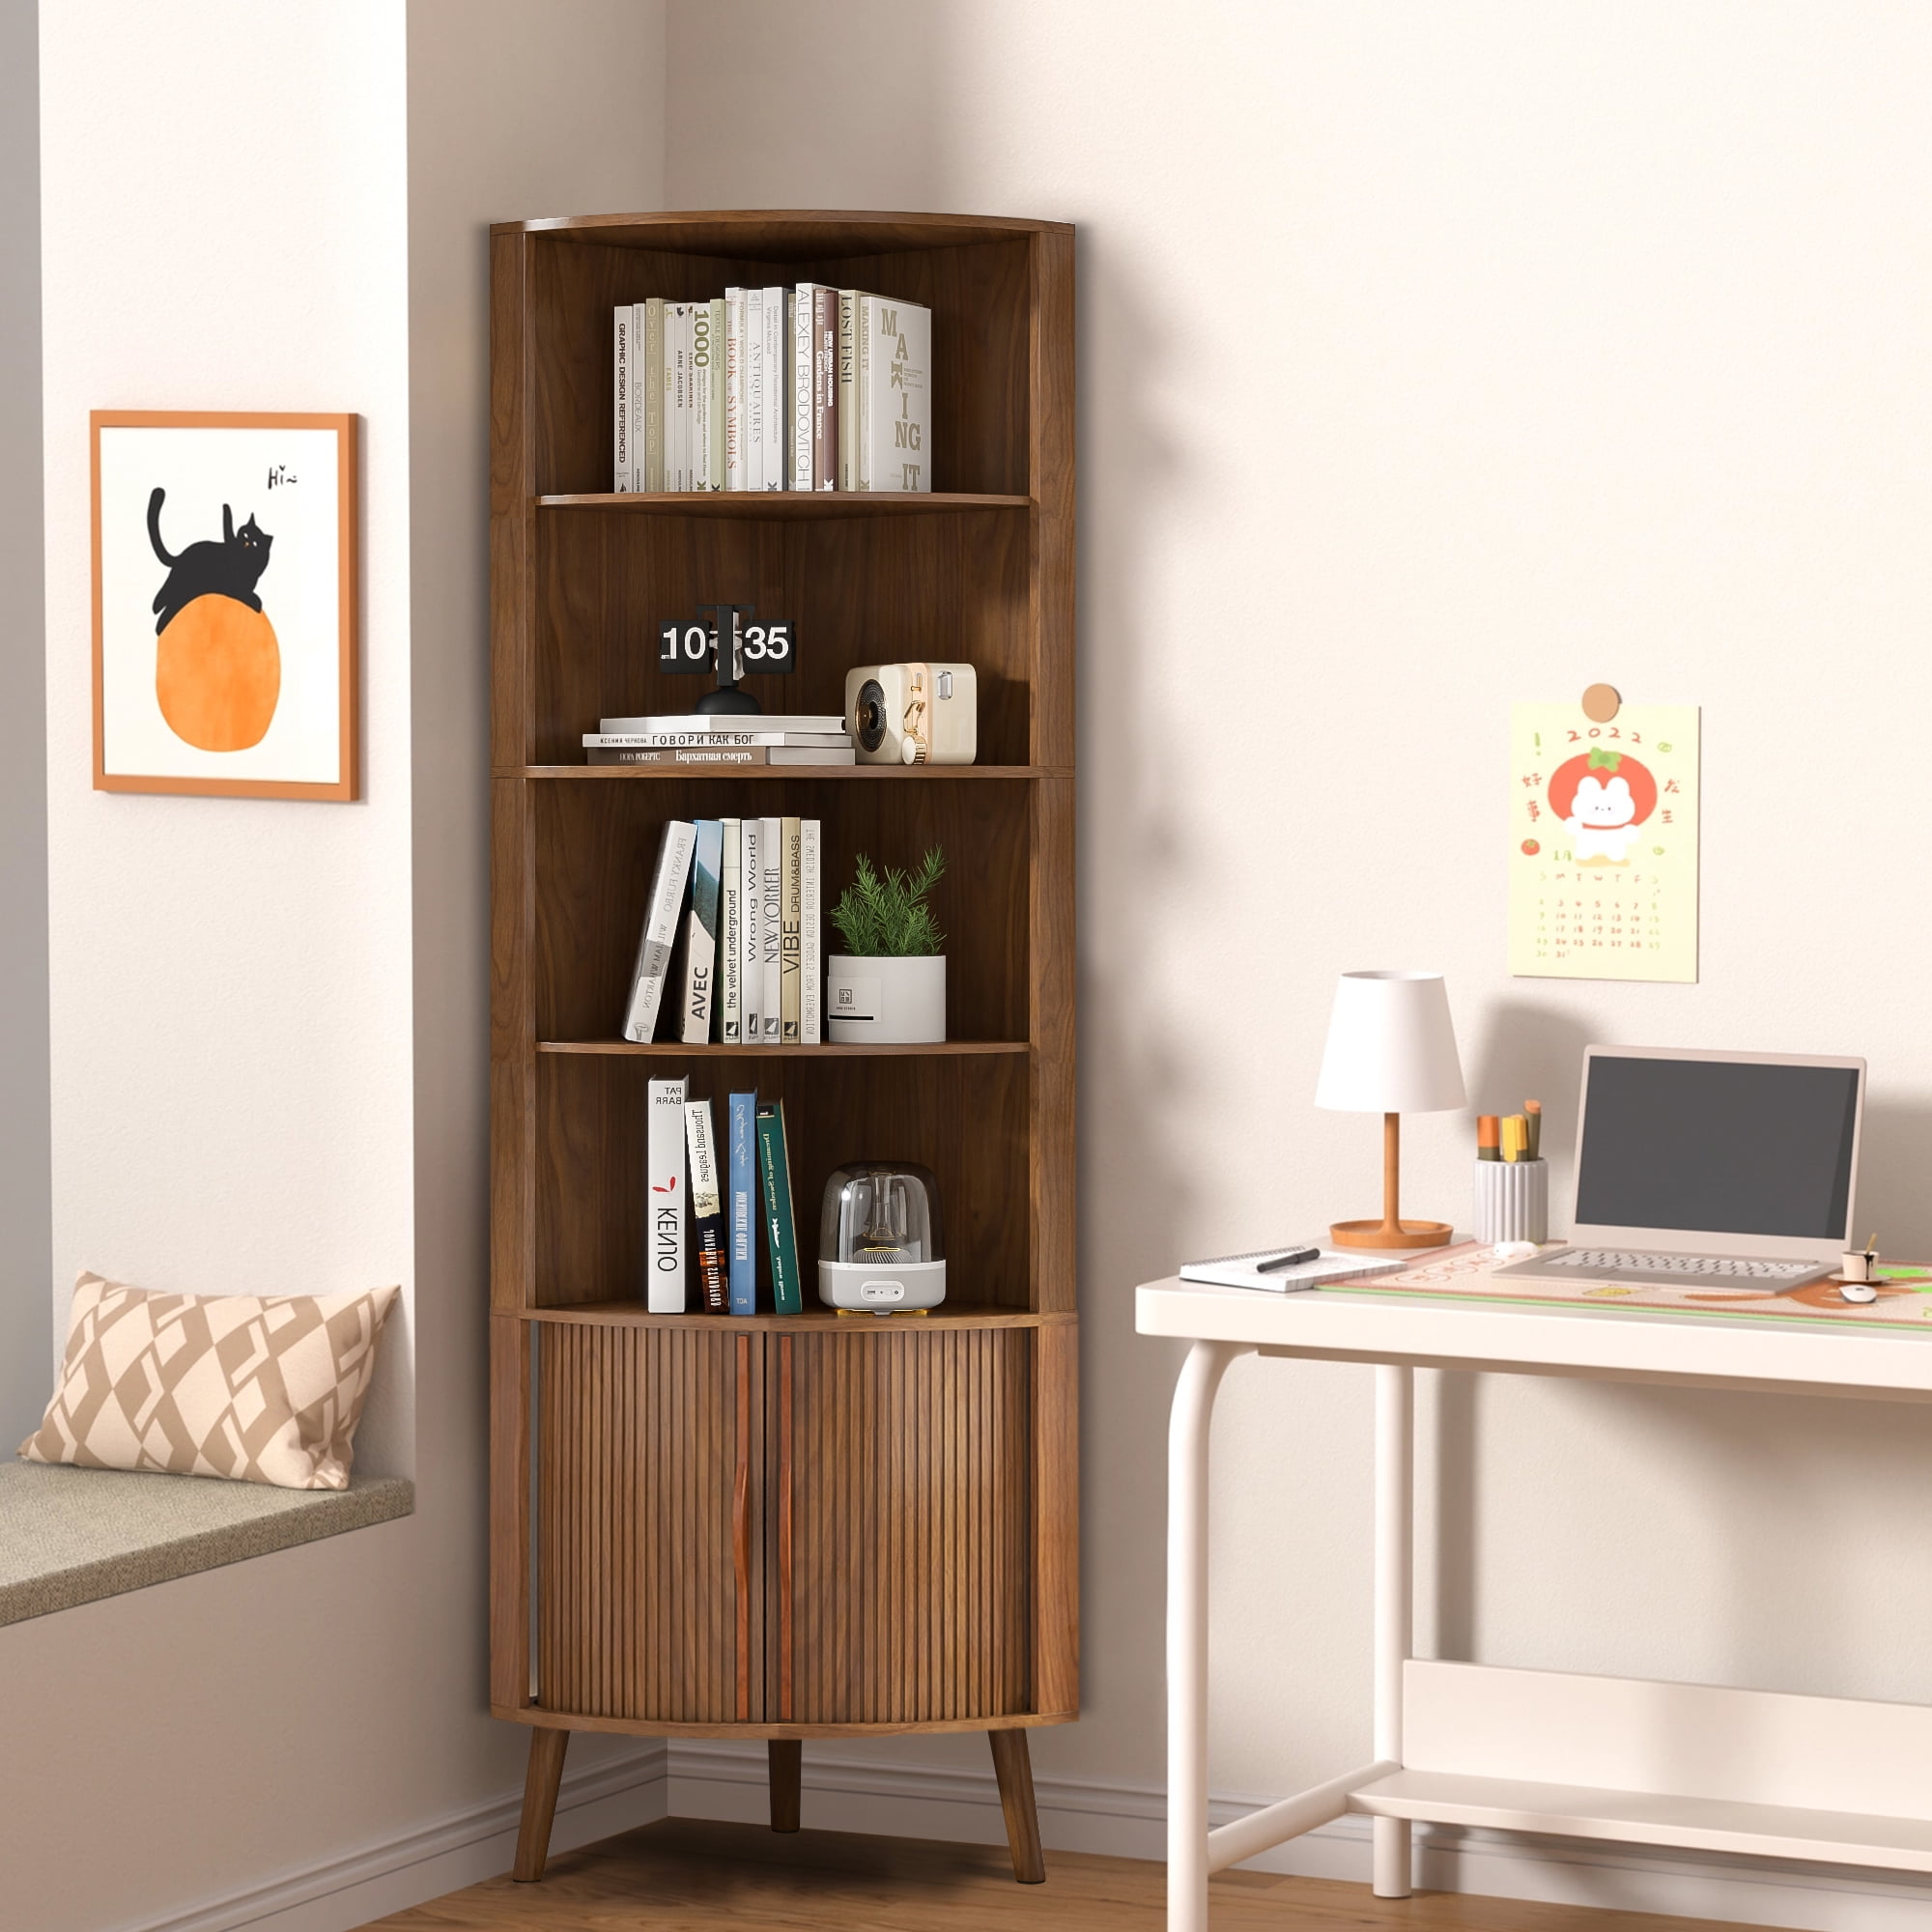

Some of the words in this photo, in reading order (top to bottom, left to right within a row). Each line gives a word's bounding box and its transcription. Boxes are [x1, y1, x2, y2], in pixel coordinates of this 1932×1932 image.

[695, 310, 709, 367] 1000
[798, 290, 810, 358] ALEXEY
[841, 296, 852, 340] LOST
[727, 338, 737, 380] BOOK
[841, 346, 852, 384] FISH
[862, 355, 869, 370] IT
[753, 342, 761, 443] ANTIQUAIRES
[816, 393, 824, 403] in
[727, 395, 737, 469] SYMBOLS
[798, 364, 810, 482] BRODOVITCH
[902, 464, 920, 491] IT
[663, 627, 706, 659] 10
[744, 626, 789, 660] 35
[652, 735, 704, 745] ГОВОРИ
[709, 735, 729, 745] КАК
[734, 735, 754, 745] БОГ
[1567, 726, 1641, 744] 2022
[675, 750, 721, 764] Бархатная
[723, 752, 753, 764] смерть
[748, 834, 756, 892] World
[791, 835, 800, 913] DRUM&BASS
[764, 867, 781, 925] YORKER
[726, 890, 739, 955] underground
[748, 898, 758, 962] Wrong
[764, 929, 780, 964] NEW
[783, 921, 800, 975] VIBE
[692, 966, 709, 1020] AVEC
[726, 958, 736, 989] velvet
[726, 992, 736, 1009] the
